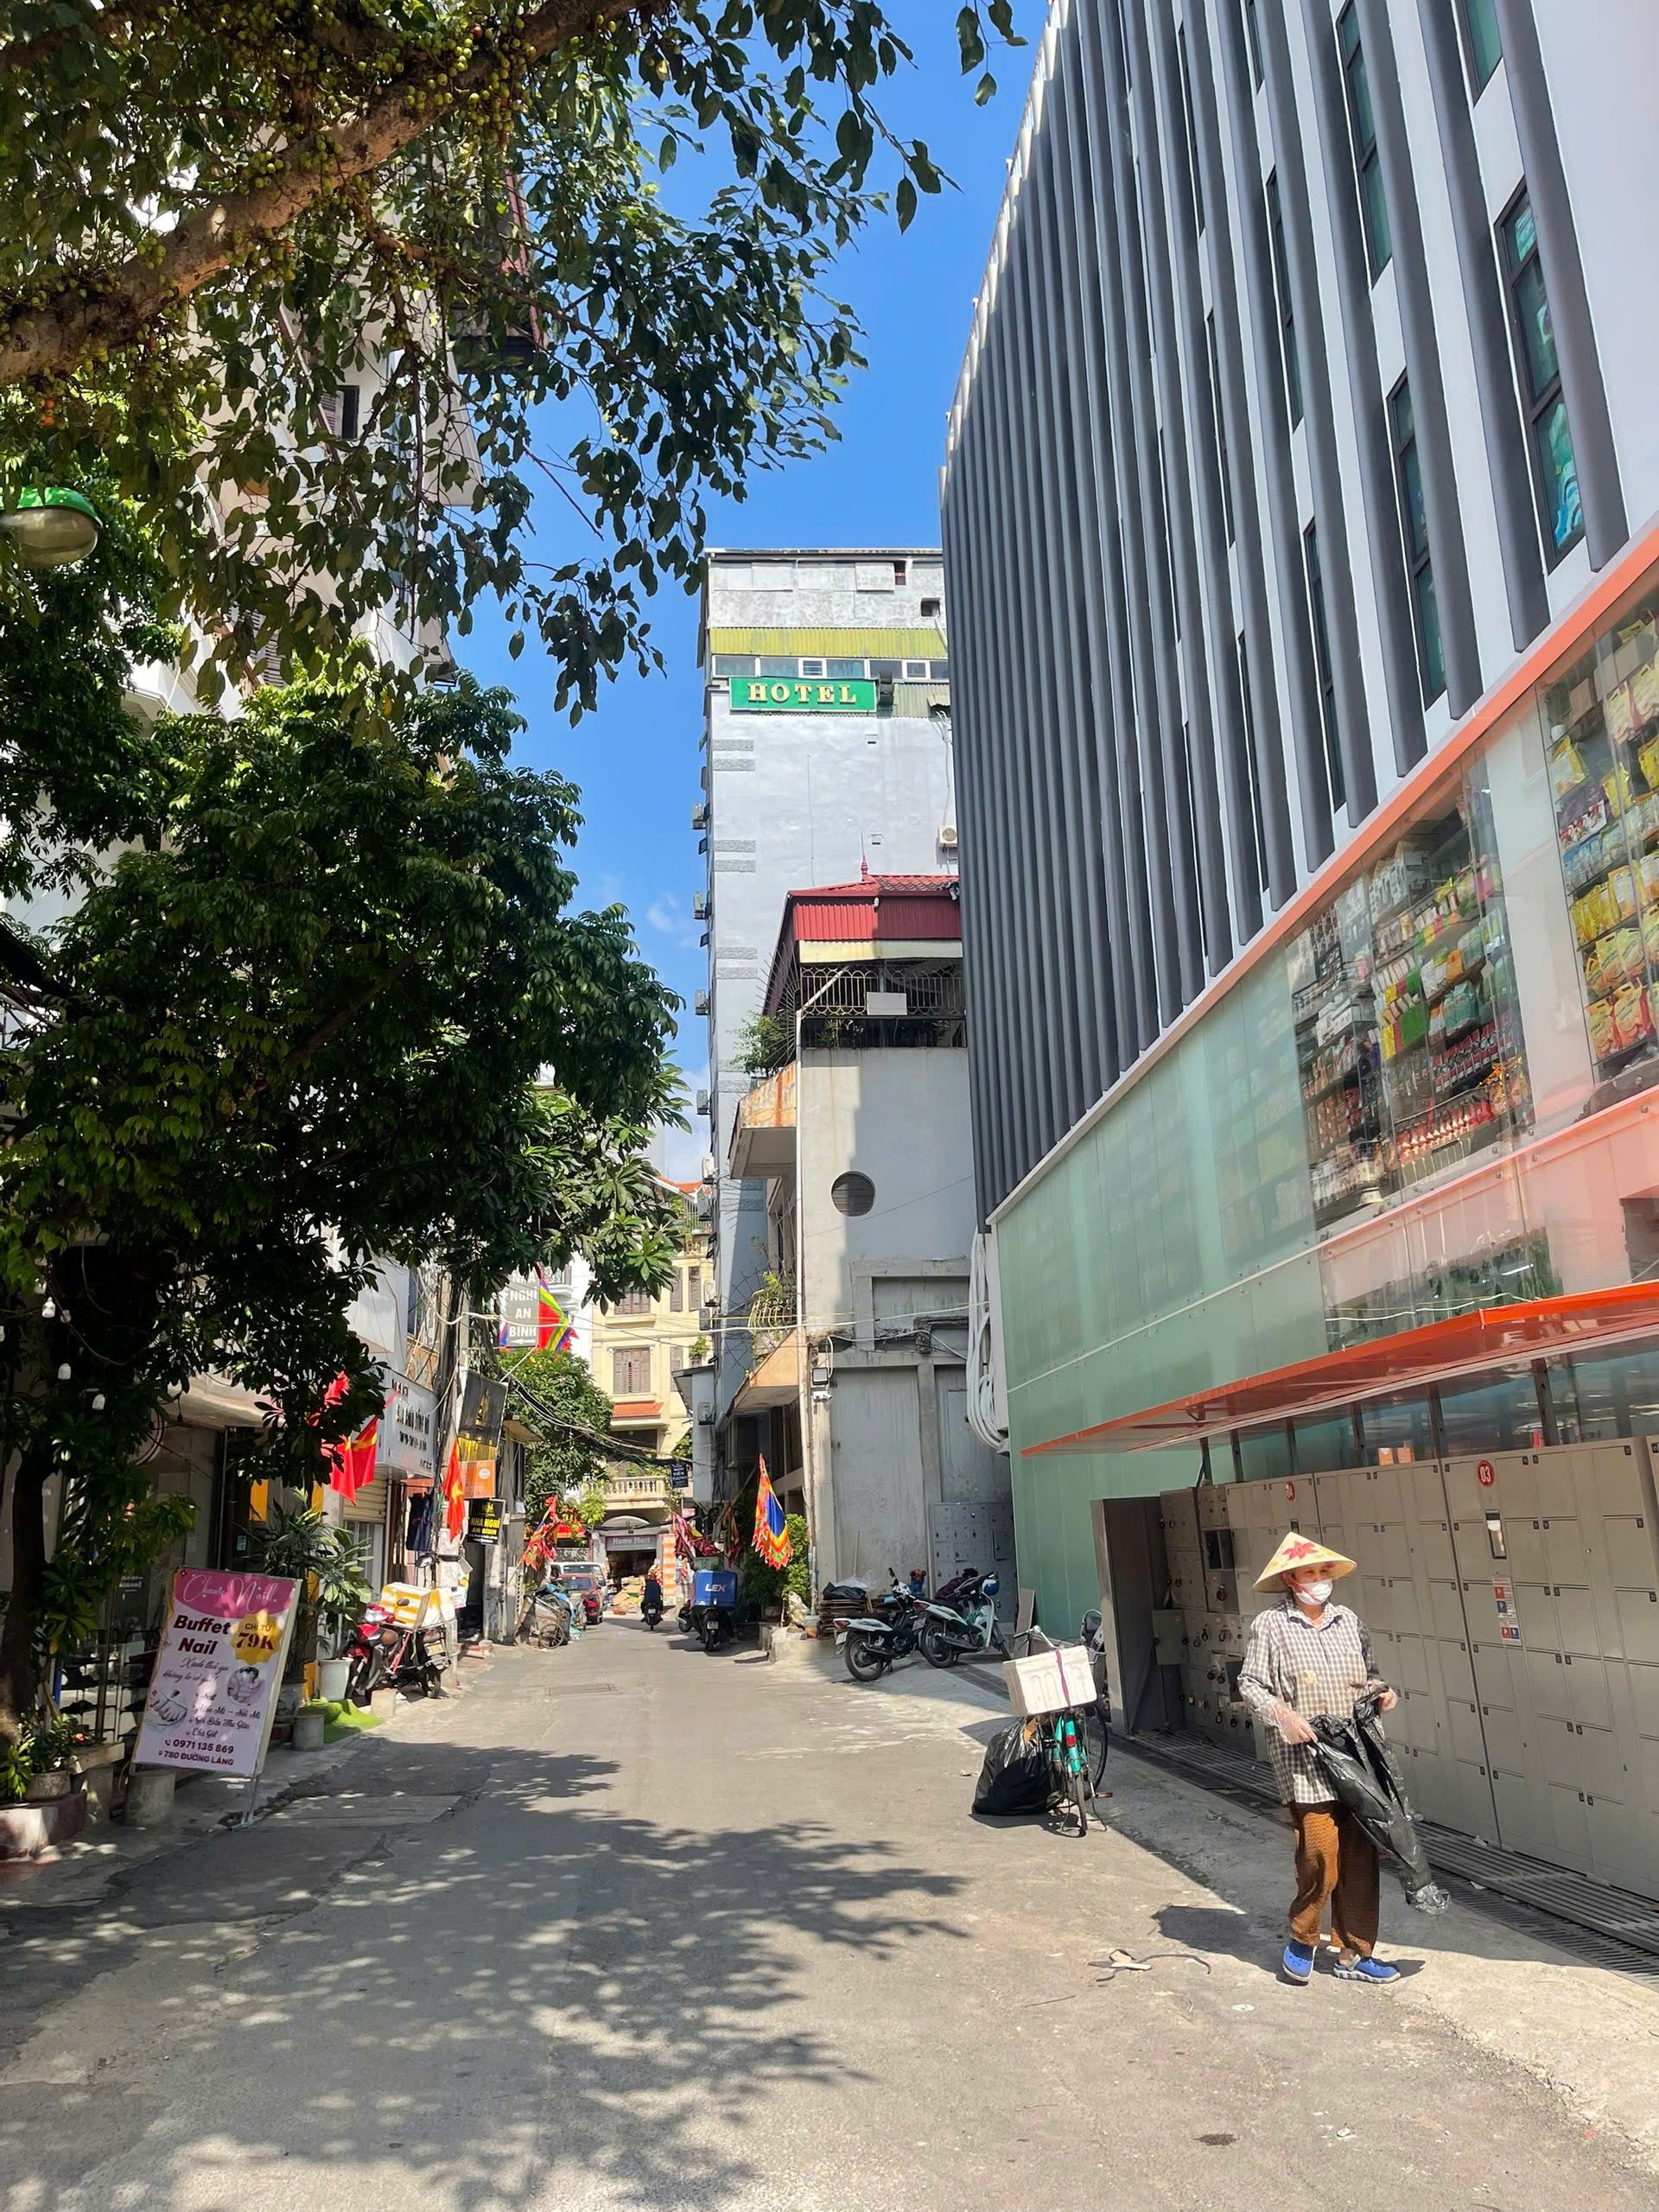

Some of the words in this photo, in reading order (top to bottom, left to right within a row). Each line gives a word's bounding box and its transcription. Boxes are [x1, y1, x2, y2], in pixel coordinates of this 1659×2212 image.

[747, 683, 857, 704] HOTEL
[515, 1307, 531, 1319] AN
[1478, 1466, 1492, 1484] 03
[704, 1583, 727, 1592] LEX
[174, 1614, 232, 1635] Buffet
[178, 1637, 219, 1655] Nail
[236, 1632, 274, 1650] 79K
[173, 1738, 195, 1750] 0971
[198, 1742, 214, 1751] 135
[215, 1744, 234, 1754] 869
